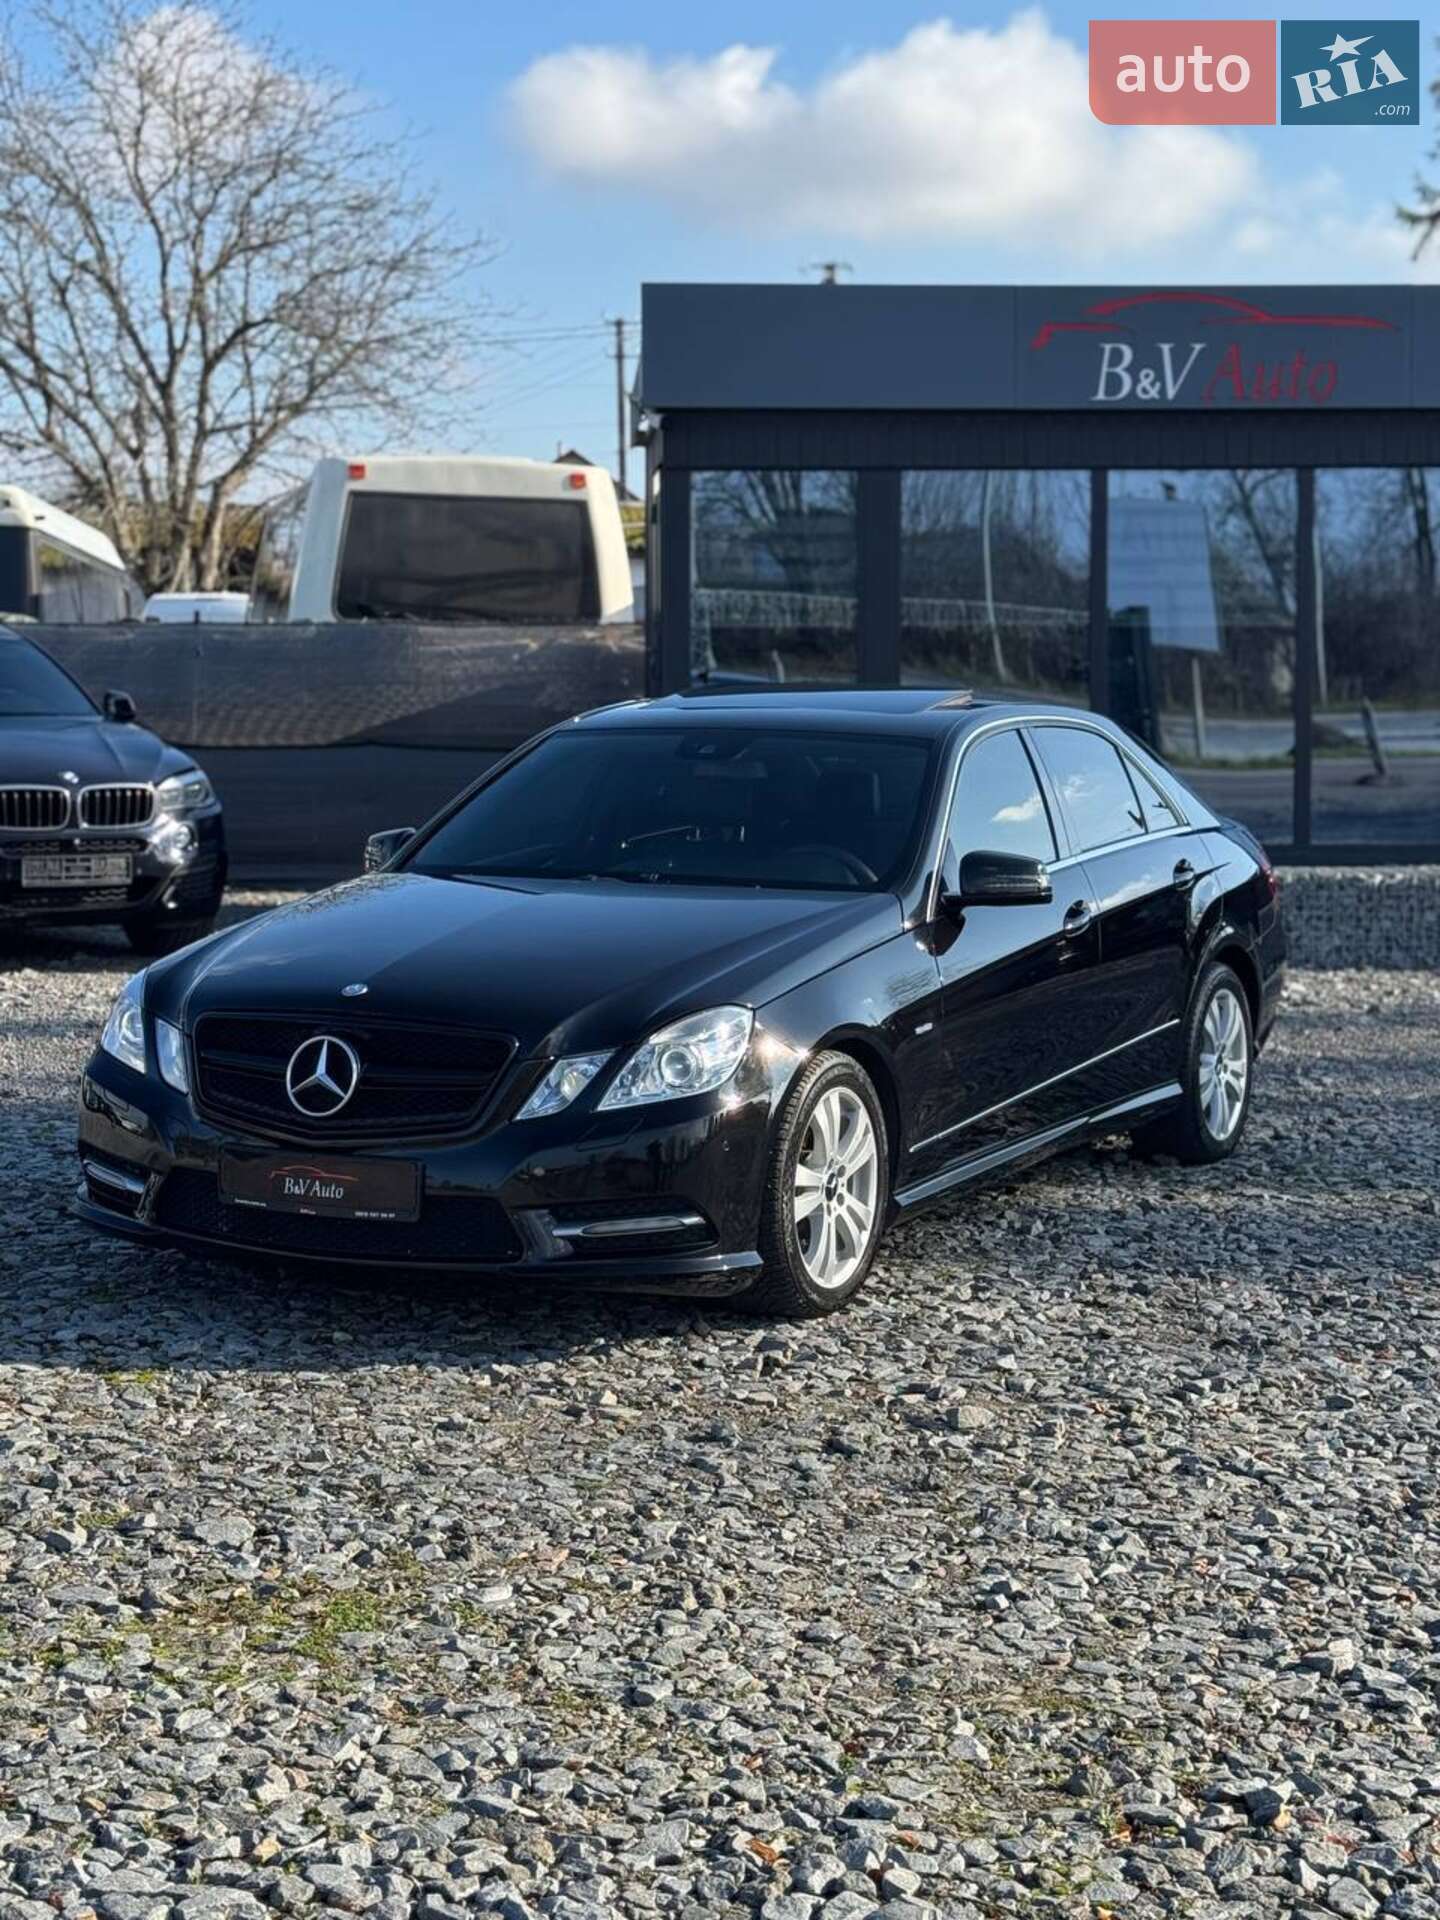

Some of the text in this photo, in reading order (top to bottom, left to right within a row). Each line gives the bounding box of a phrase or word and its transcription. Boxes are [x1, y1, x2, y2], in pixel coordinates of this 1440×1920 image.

[1091, 342, 1339, 407] B&V Auto
[284, 1177, 345, 1200] B&V Auto
